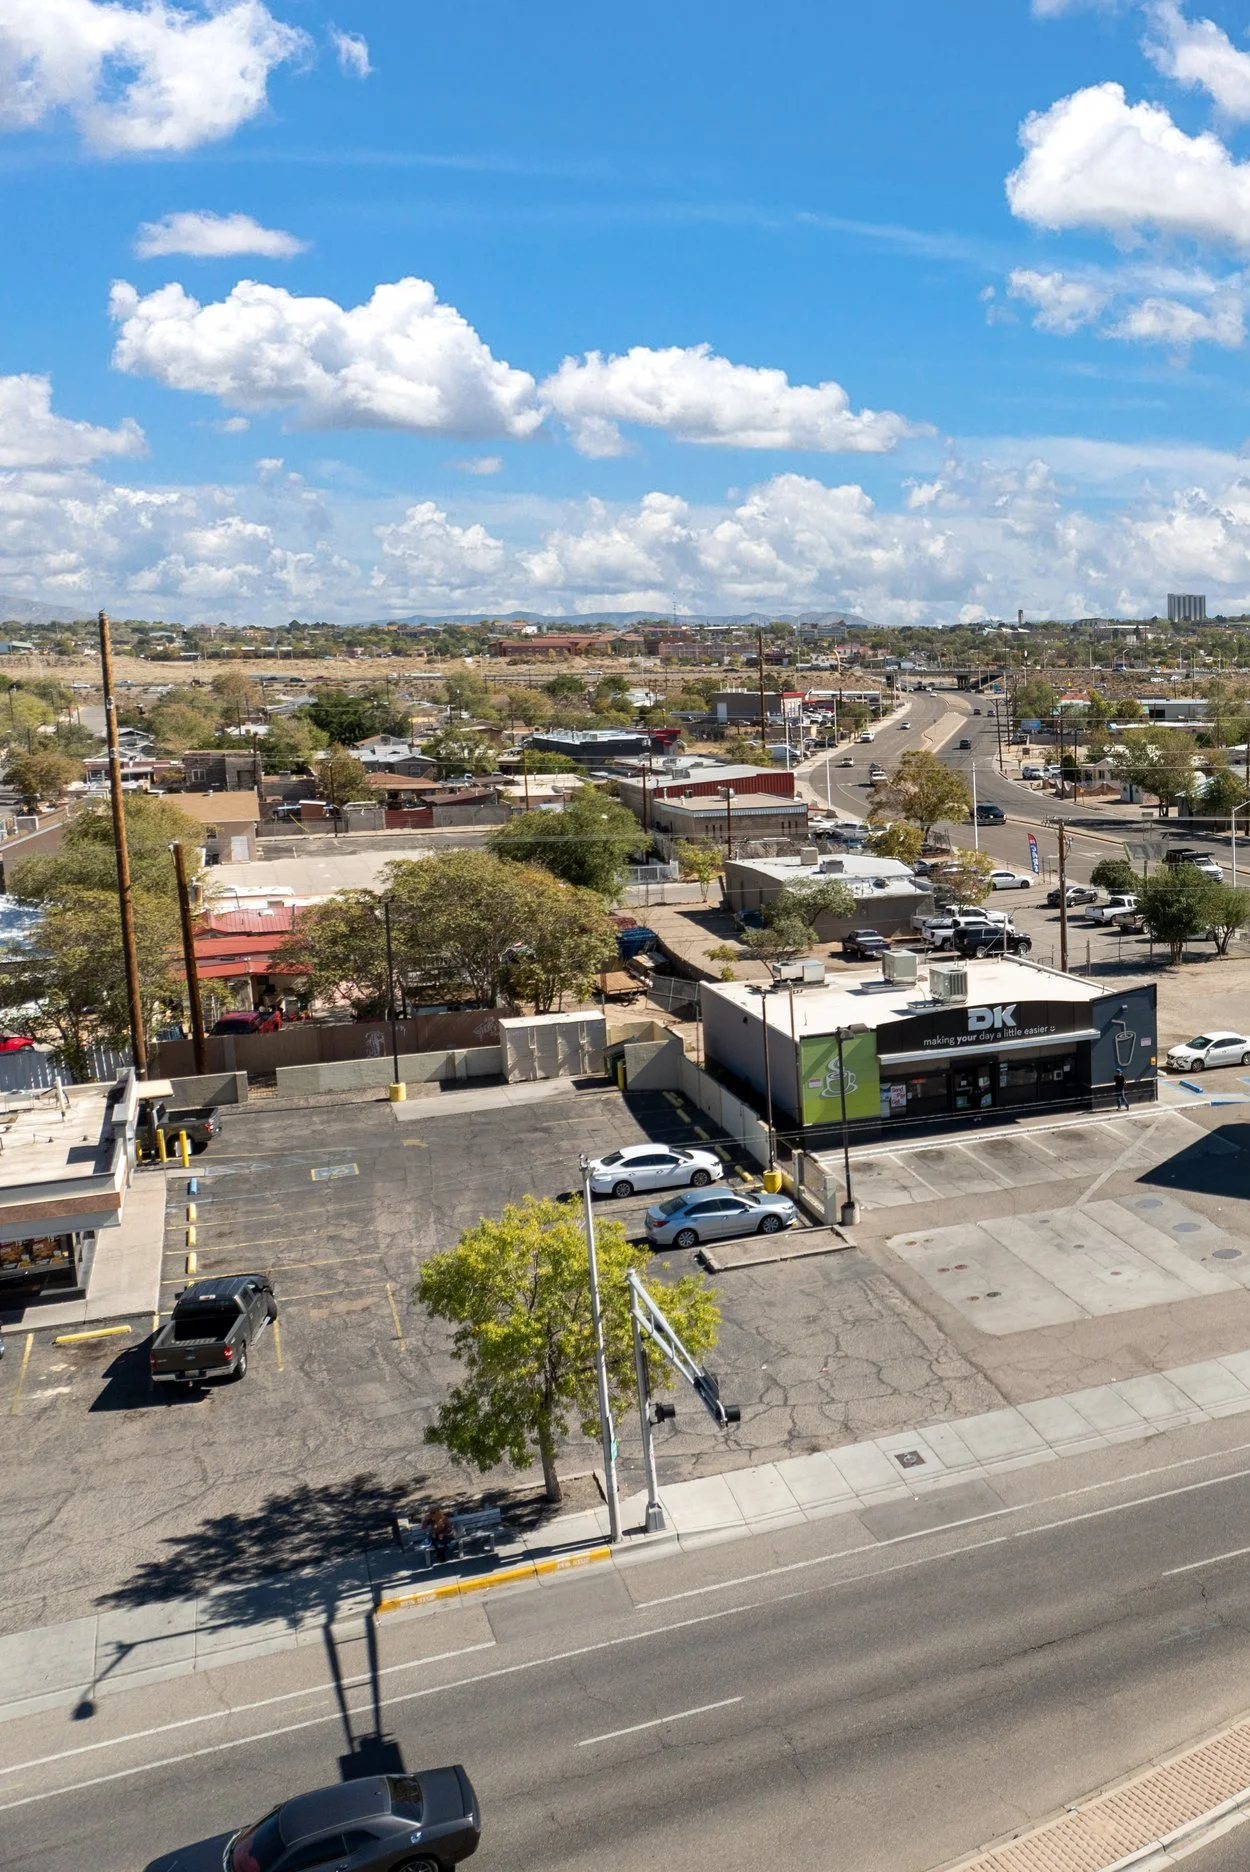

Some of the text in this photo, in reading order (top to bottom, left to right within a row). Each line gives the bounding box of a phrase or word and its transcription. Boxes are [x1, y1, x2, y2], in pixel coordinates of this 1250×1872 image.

[968, 1004, 1017, 1031] DK
[923, 1035, 955, 1046] making
[957, 1033, 977, 1045] your
[979, 1031, 994, 1041] day
[1003, 1027, 1022, 1038] little
[1024, 1025, 1048, 1035] easier
